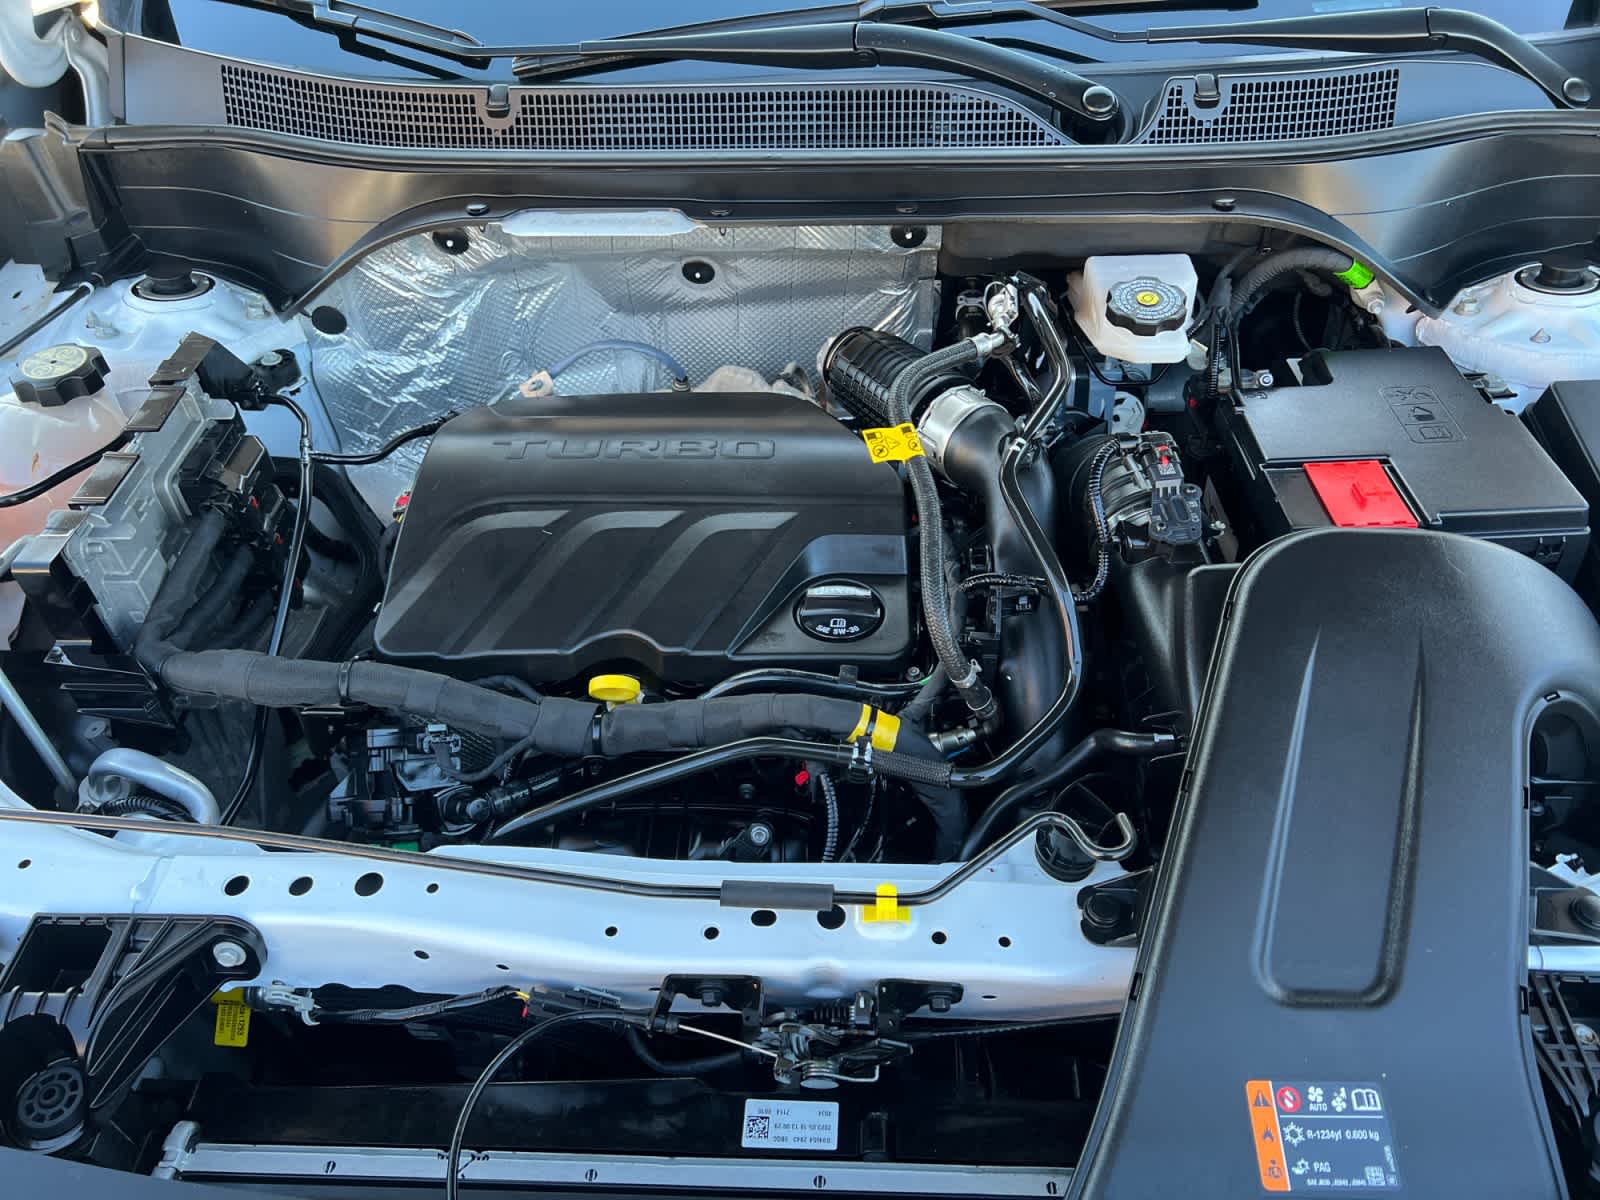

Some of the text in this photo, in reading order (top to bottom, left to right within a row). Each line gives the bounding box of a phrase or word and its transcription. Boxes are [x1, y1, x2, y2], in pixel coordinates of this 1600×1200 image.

[492, 439, 776, 460] TURBO
[815, 624, 860, 635] SAE 5W-30
[1308, 1102, 1328, 1113] AUTO
[1306, 1129, 1380, 1142] R-1234yf 0.600 kg
[1313, 1161, 1331, 1173] PAG
